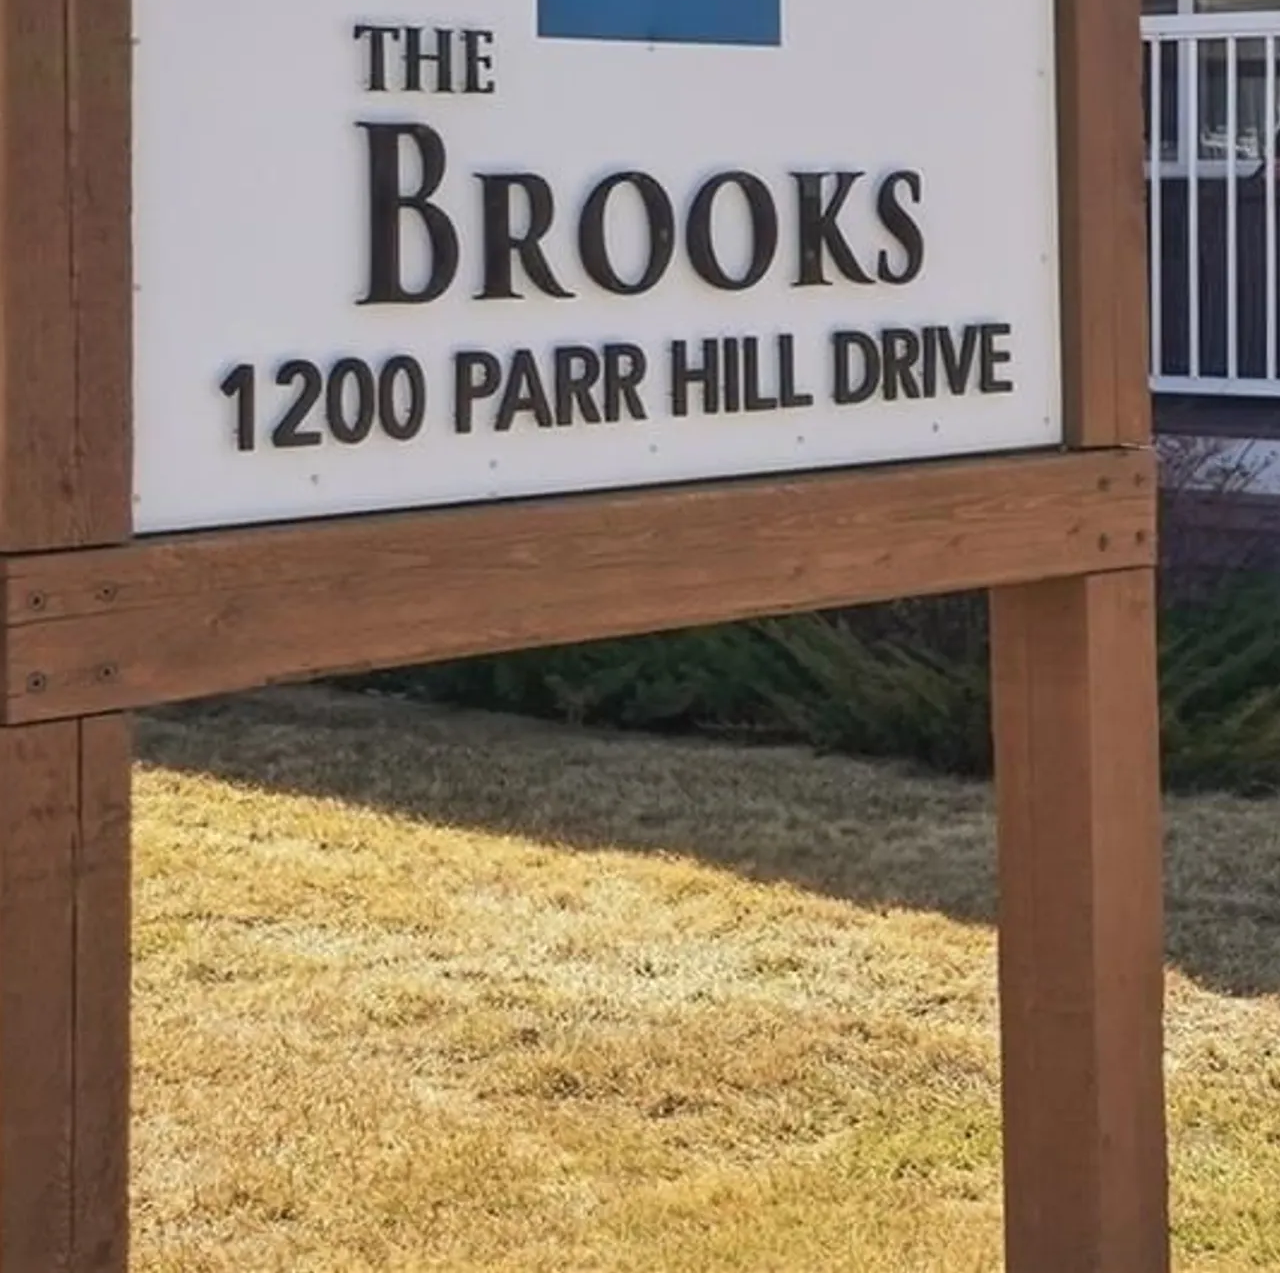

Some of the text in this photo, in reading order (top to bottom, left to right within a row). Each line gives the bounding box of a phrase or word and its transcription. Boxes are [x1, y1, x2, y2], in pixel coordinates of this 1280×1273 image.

[353, 24, 495, 93] THE
[354, 120, 925, 306] BROOKS
[220, 323, 1014, 451] 1200 PARR HILL DRIVE
